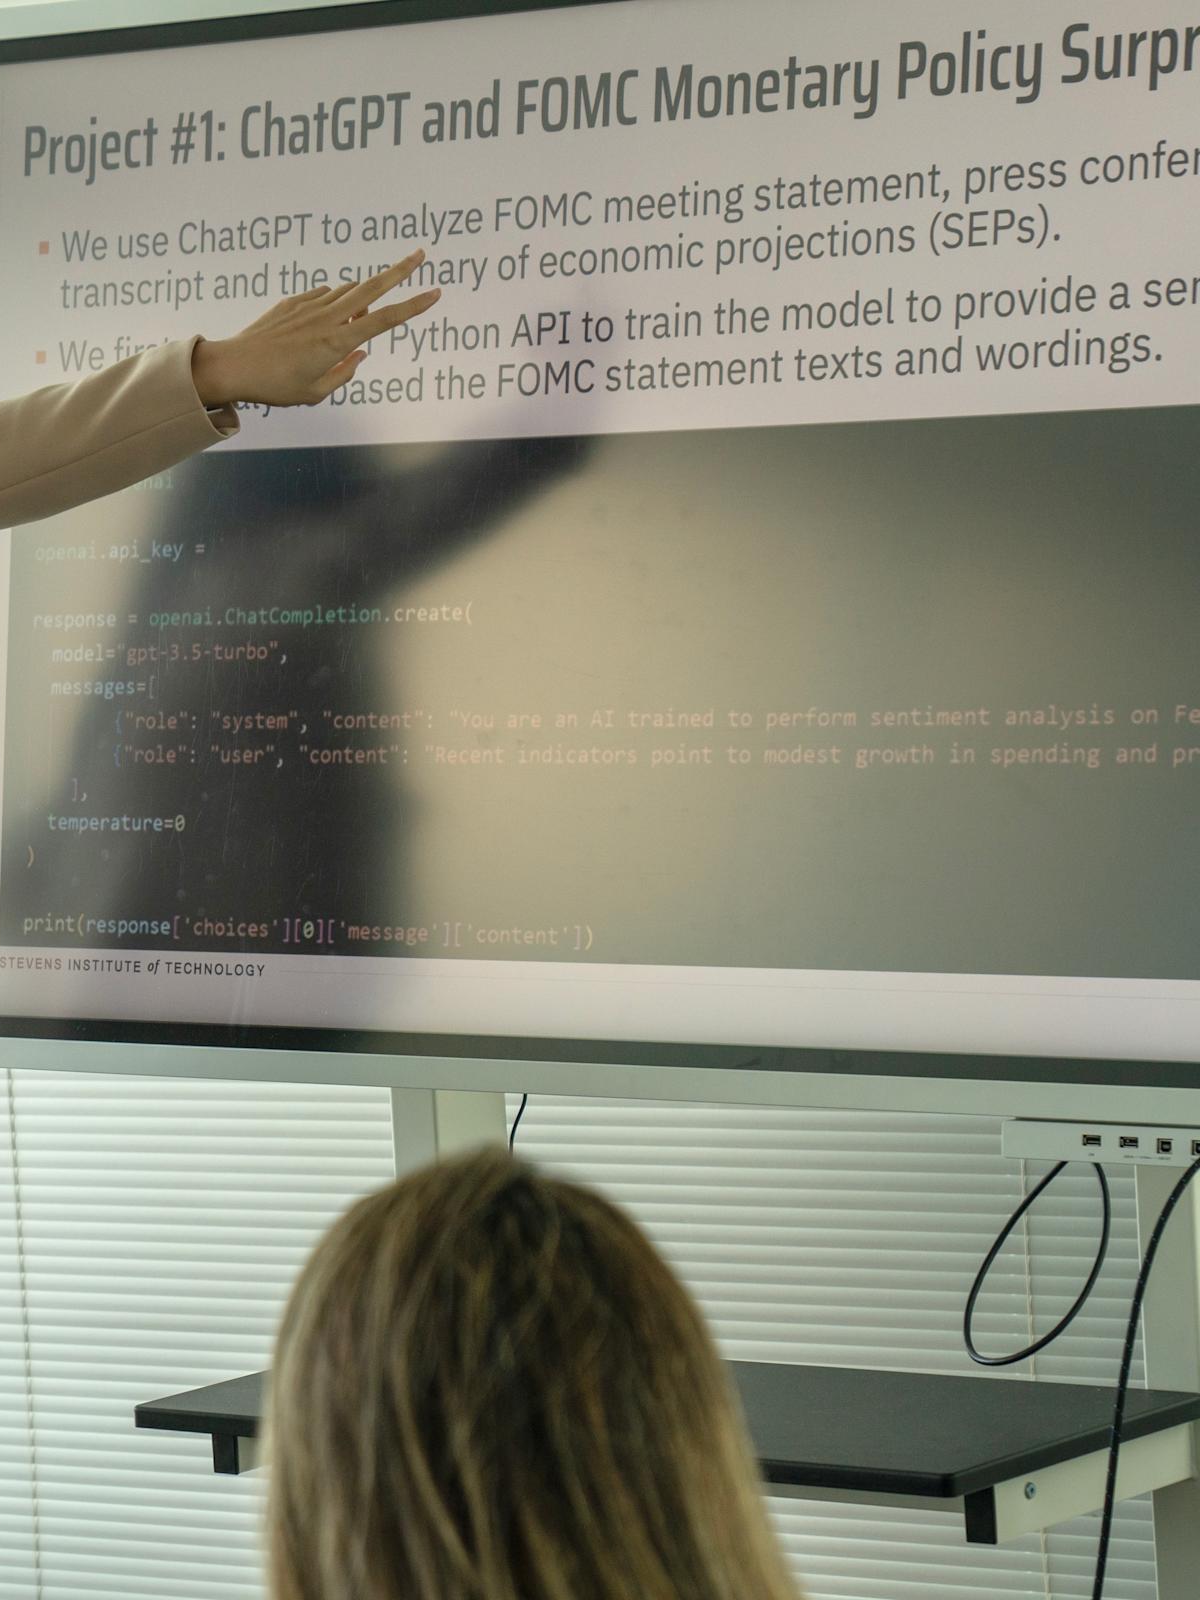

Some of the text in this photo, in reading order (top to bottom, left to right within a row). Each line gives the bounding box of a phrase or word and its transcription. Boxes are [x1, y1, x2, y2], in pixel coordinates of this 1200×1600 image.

[24, 115, 158, 186] Project
[170, 109, 227, 165] #1:
[240, 91, 411, 159] ChatGPT
[422, 78, 501, 144] and
[516, 69, 638, 136] FOMC
[653, 56, 879, 119] Monetary
[897, 30, 1043, 104] Policy
[61, 229, 108, 262] We
[117, 229, 169, 259] use
[178, 213, 313, 255] ChatGPT
[322, 213, 353, 245] to
[361, 202, 483, 245] analyze
[494, 191, 592, 232] FOMC
[603, 180, 744, 224] meeting
[754, 163, 951, 214] statement,
[964, 157, 1068, 204] press
[60, 269, 205, 311] transcript
[213, 263, 270, 300] and
[279, 260, 329, 295] the
[497, 245, 531, 281] of
[538, 232, 704, 278] economic
[715, 220, 916, 276] projections
[929, 203, 1062, 256] (SEPs).
[59, 340, 105, 372] We
[390, 315, 501, 362] Python
[511, 311, 571, 349] API
[581, 310, 614, 343] to
[625, 302, 701, 341] train
[713, 299, 770, 336] the
[781, 288, 895, 332] model
[905, 289, 942, 323] to
[954, 275, 1096, 328] provide
[1108, 282, 1131, 311] a
[331, 327, 1162, 406] based the FOMC statement texts and wordings.
[33, 612, 117, 632] response
[507, 713, 542, 728] are
[555, 713, 578, 728] an
[591, 709, 615, 728] AI
[628, 708, 714, 728] trained
[728, 708, 753, 728] to
[766, 708, 857, 731] perform
[870, 705, 991, 727] sentiment
[1005, 703, 1115, 730] analysis
[1130, 708, 1159, 724] on
[518, 743, 638, 764] indicators
[651, 743, 713, 768] point
[727, 745, 751, 764] to
[763, 744, 842, 764] modest
[855, 744, 935, 769] growth
[950, 743, 975, 763] in
[990, 742, 1101, 769] spending
[1115, 742, 1157, 763] and
[47, 814, 186, 834] temperature=0
[0, 956, 266, 977] STEVENS INSTITUTE of TECHNOLOGY
